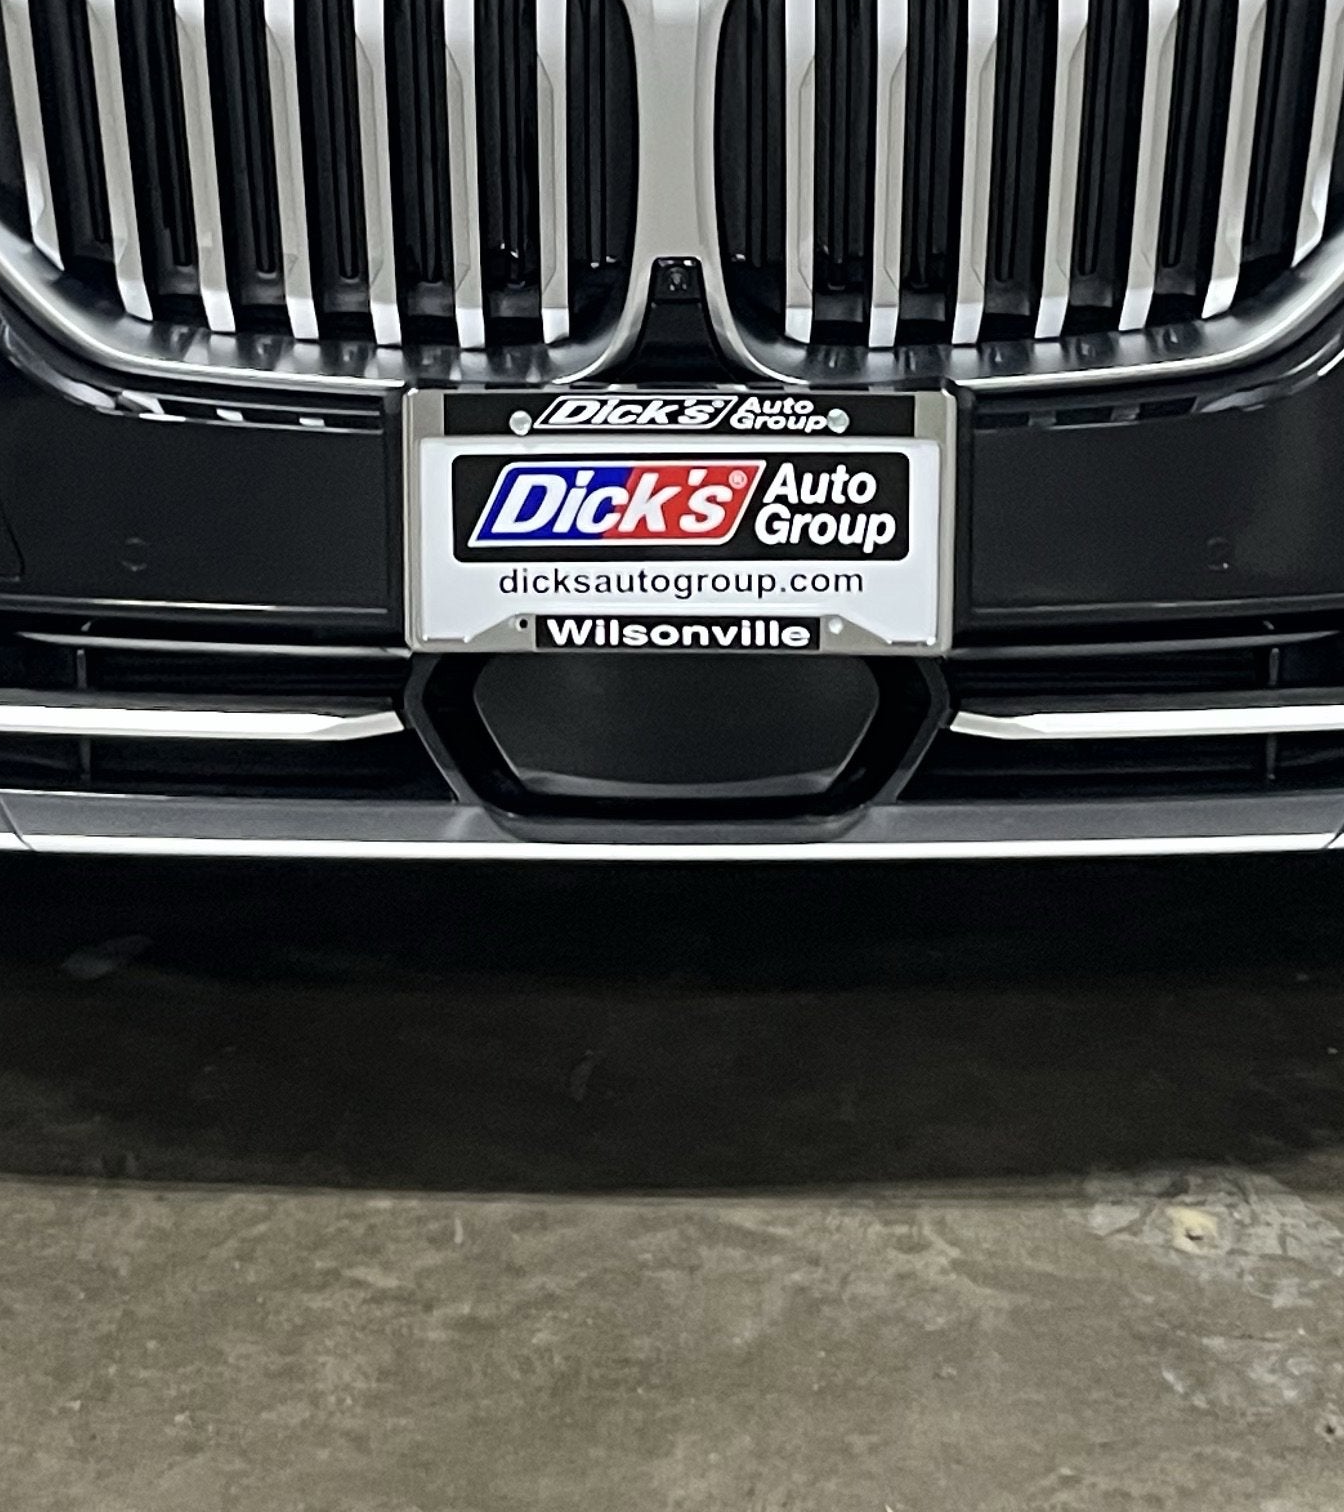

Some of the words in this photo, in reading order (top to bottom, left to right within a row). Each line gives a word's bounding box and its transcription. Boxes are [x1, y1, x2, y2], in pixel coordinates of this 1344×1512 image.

[549, 398, 714, 424] Dick's
[739, 397, 814, 415] Auto
[729, 413, 828, 433] Group
[491, 469, 730, 533] Dick's
[763, 462, 877, 505] Auto
[755, 504, 897, 553] Group
[498, 569, 865, 600] dicksautogroup.com
[546, 618, 811, 647] Wilsonville
